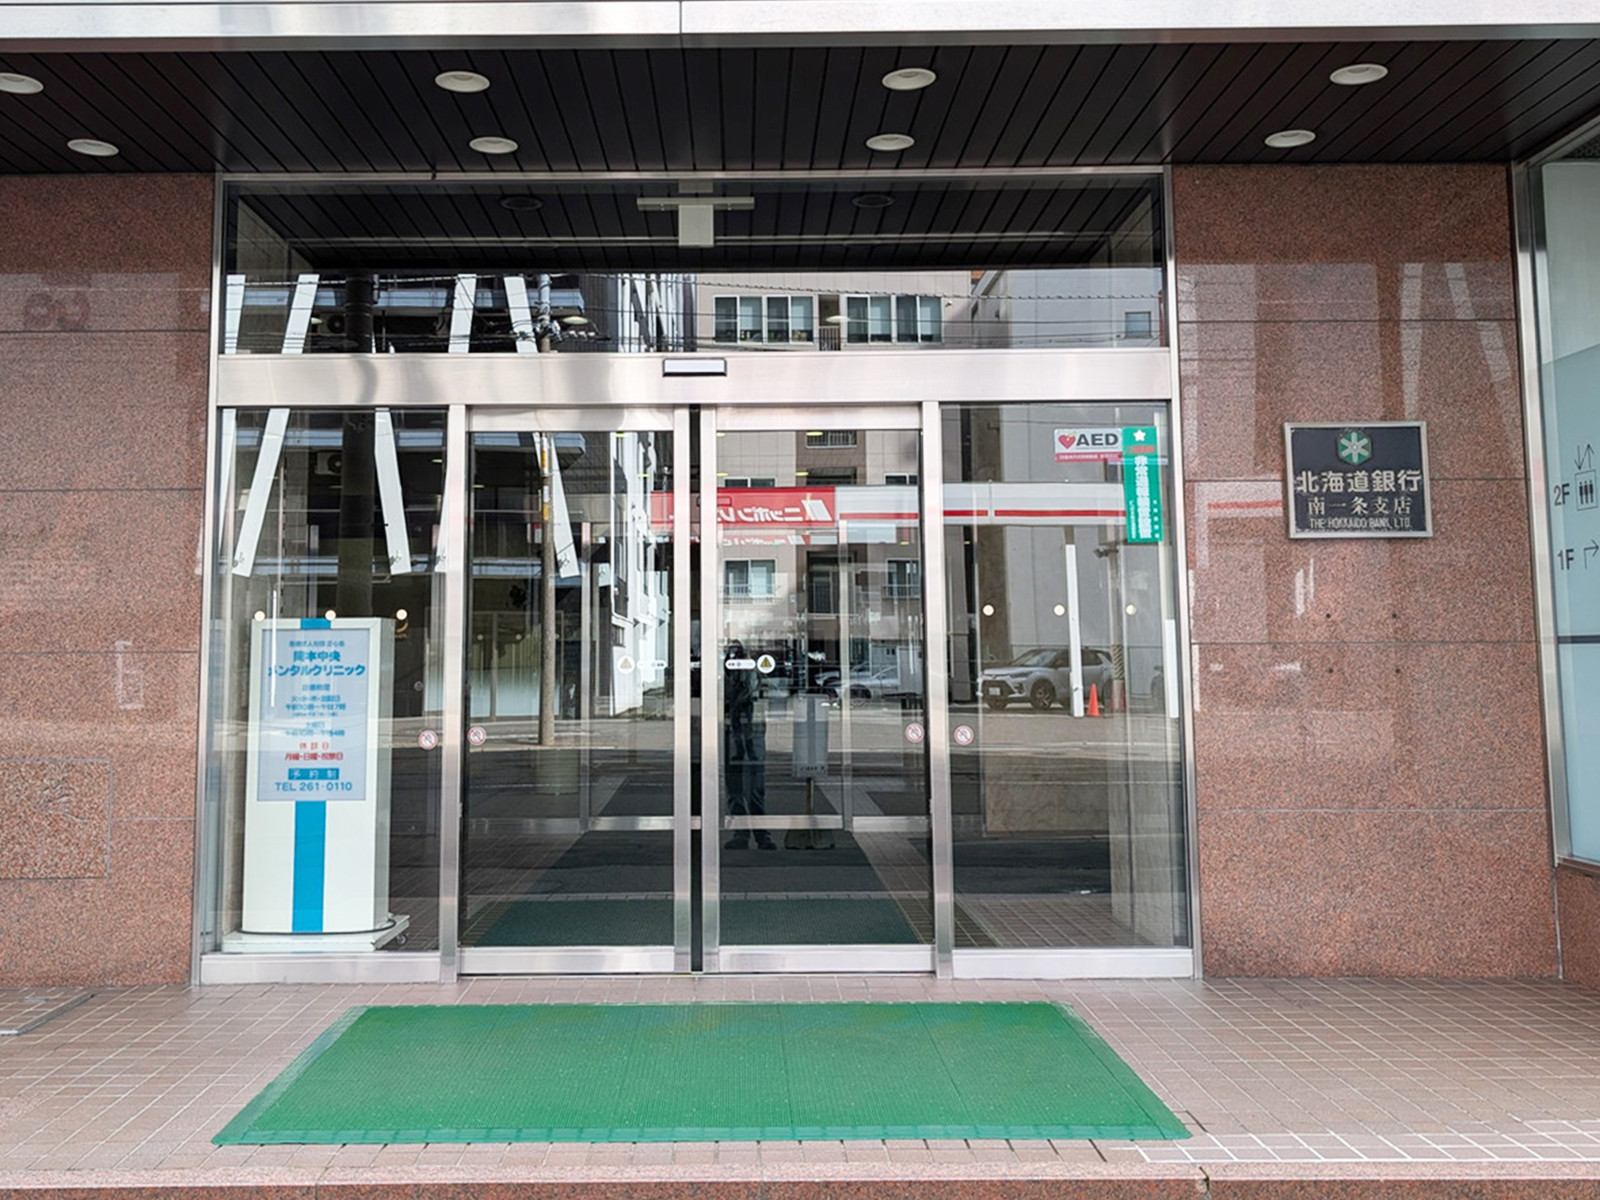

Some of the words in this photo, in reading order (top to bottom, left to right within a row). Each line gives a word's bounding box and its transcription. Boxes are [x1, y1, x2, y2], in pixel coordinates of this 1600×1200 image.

[1076, 433, 1118, 446] AED
[1295, 469, 1422, 493] 北海道銀行
[1553, 483, 1571, 506] 2F
[1307, 496, 1412, 516] 南一条支店
[1310, 517, 1327, 529] THE
[1328, 517, 1367, 529] HOKKAIDO
[1557, 549, 1575, 571] 1F
[275, 782, 296, 791] TEL
